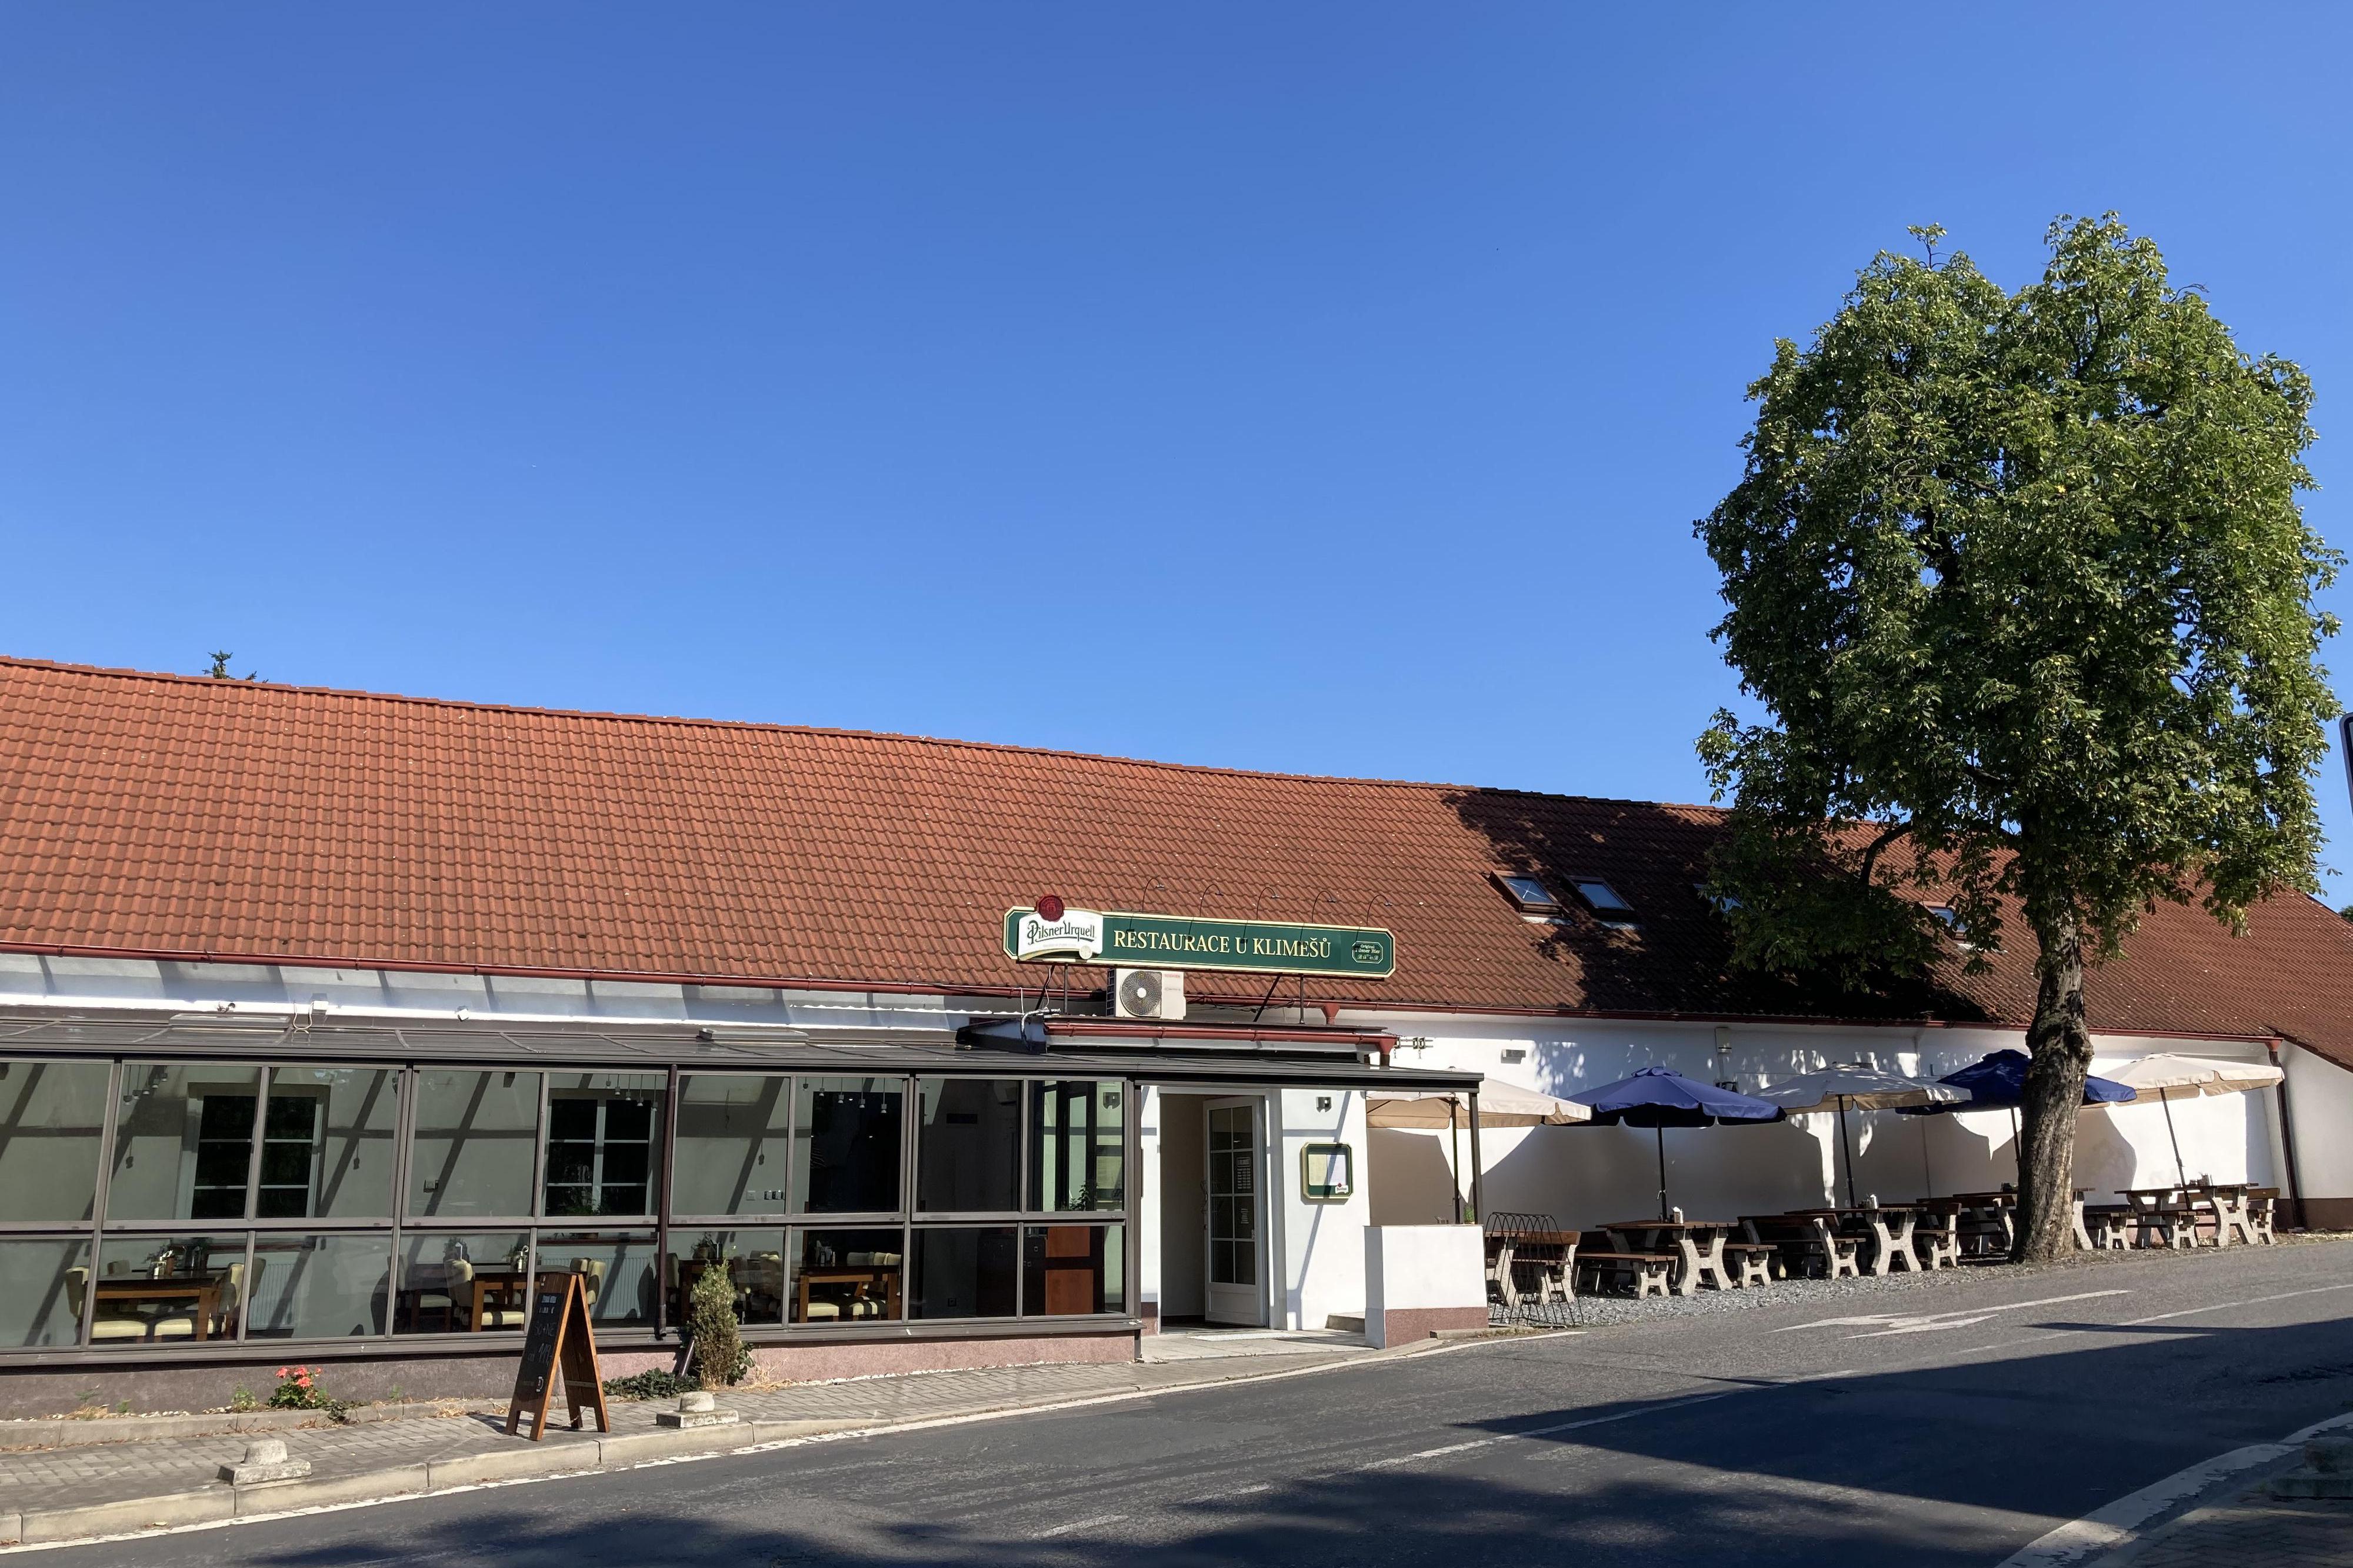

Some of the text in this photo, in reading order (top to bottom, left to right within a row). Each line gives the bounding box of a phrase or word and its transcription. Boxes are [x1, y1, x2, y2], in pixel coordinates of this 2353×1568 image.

[1026, 919, 1095, 946] Pilsner Urquell
[1113, 930, 1331, 959] RESTAURACE U KLIMEŠŮ
